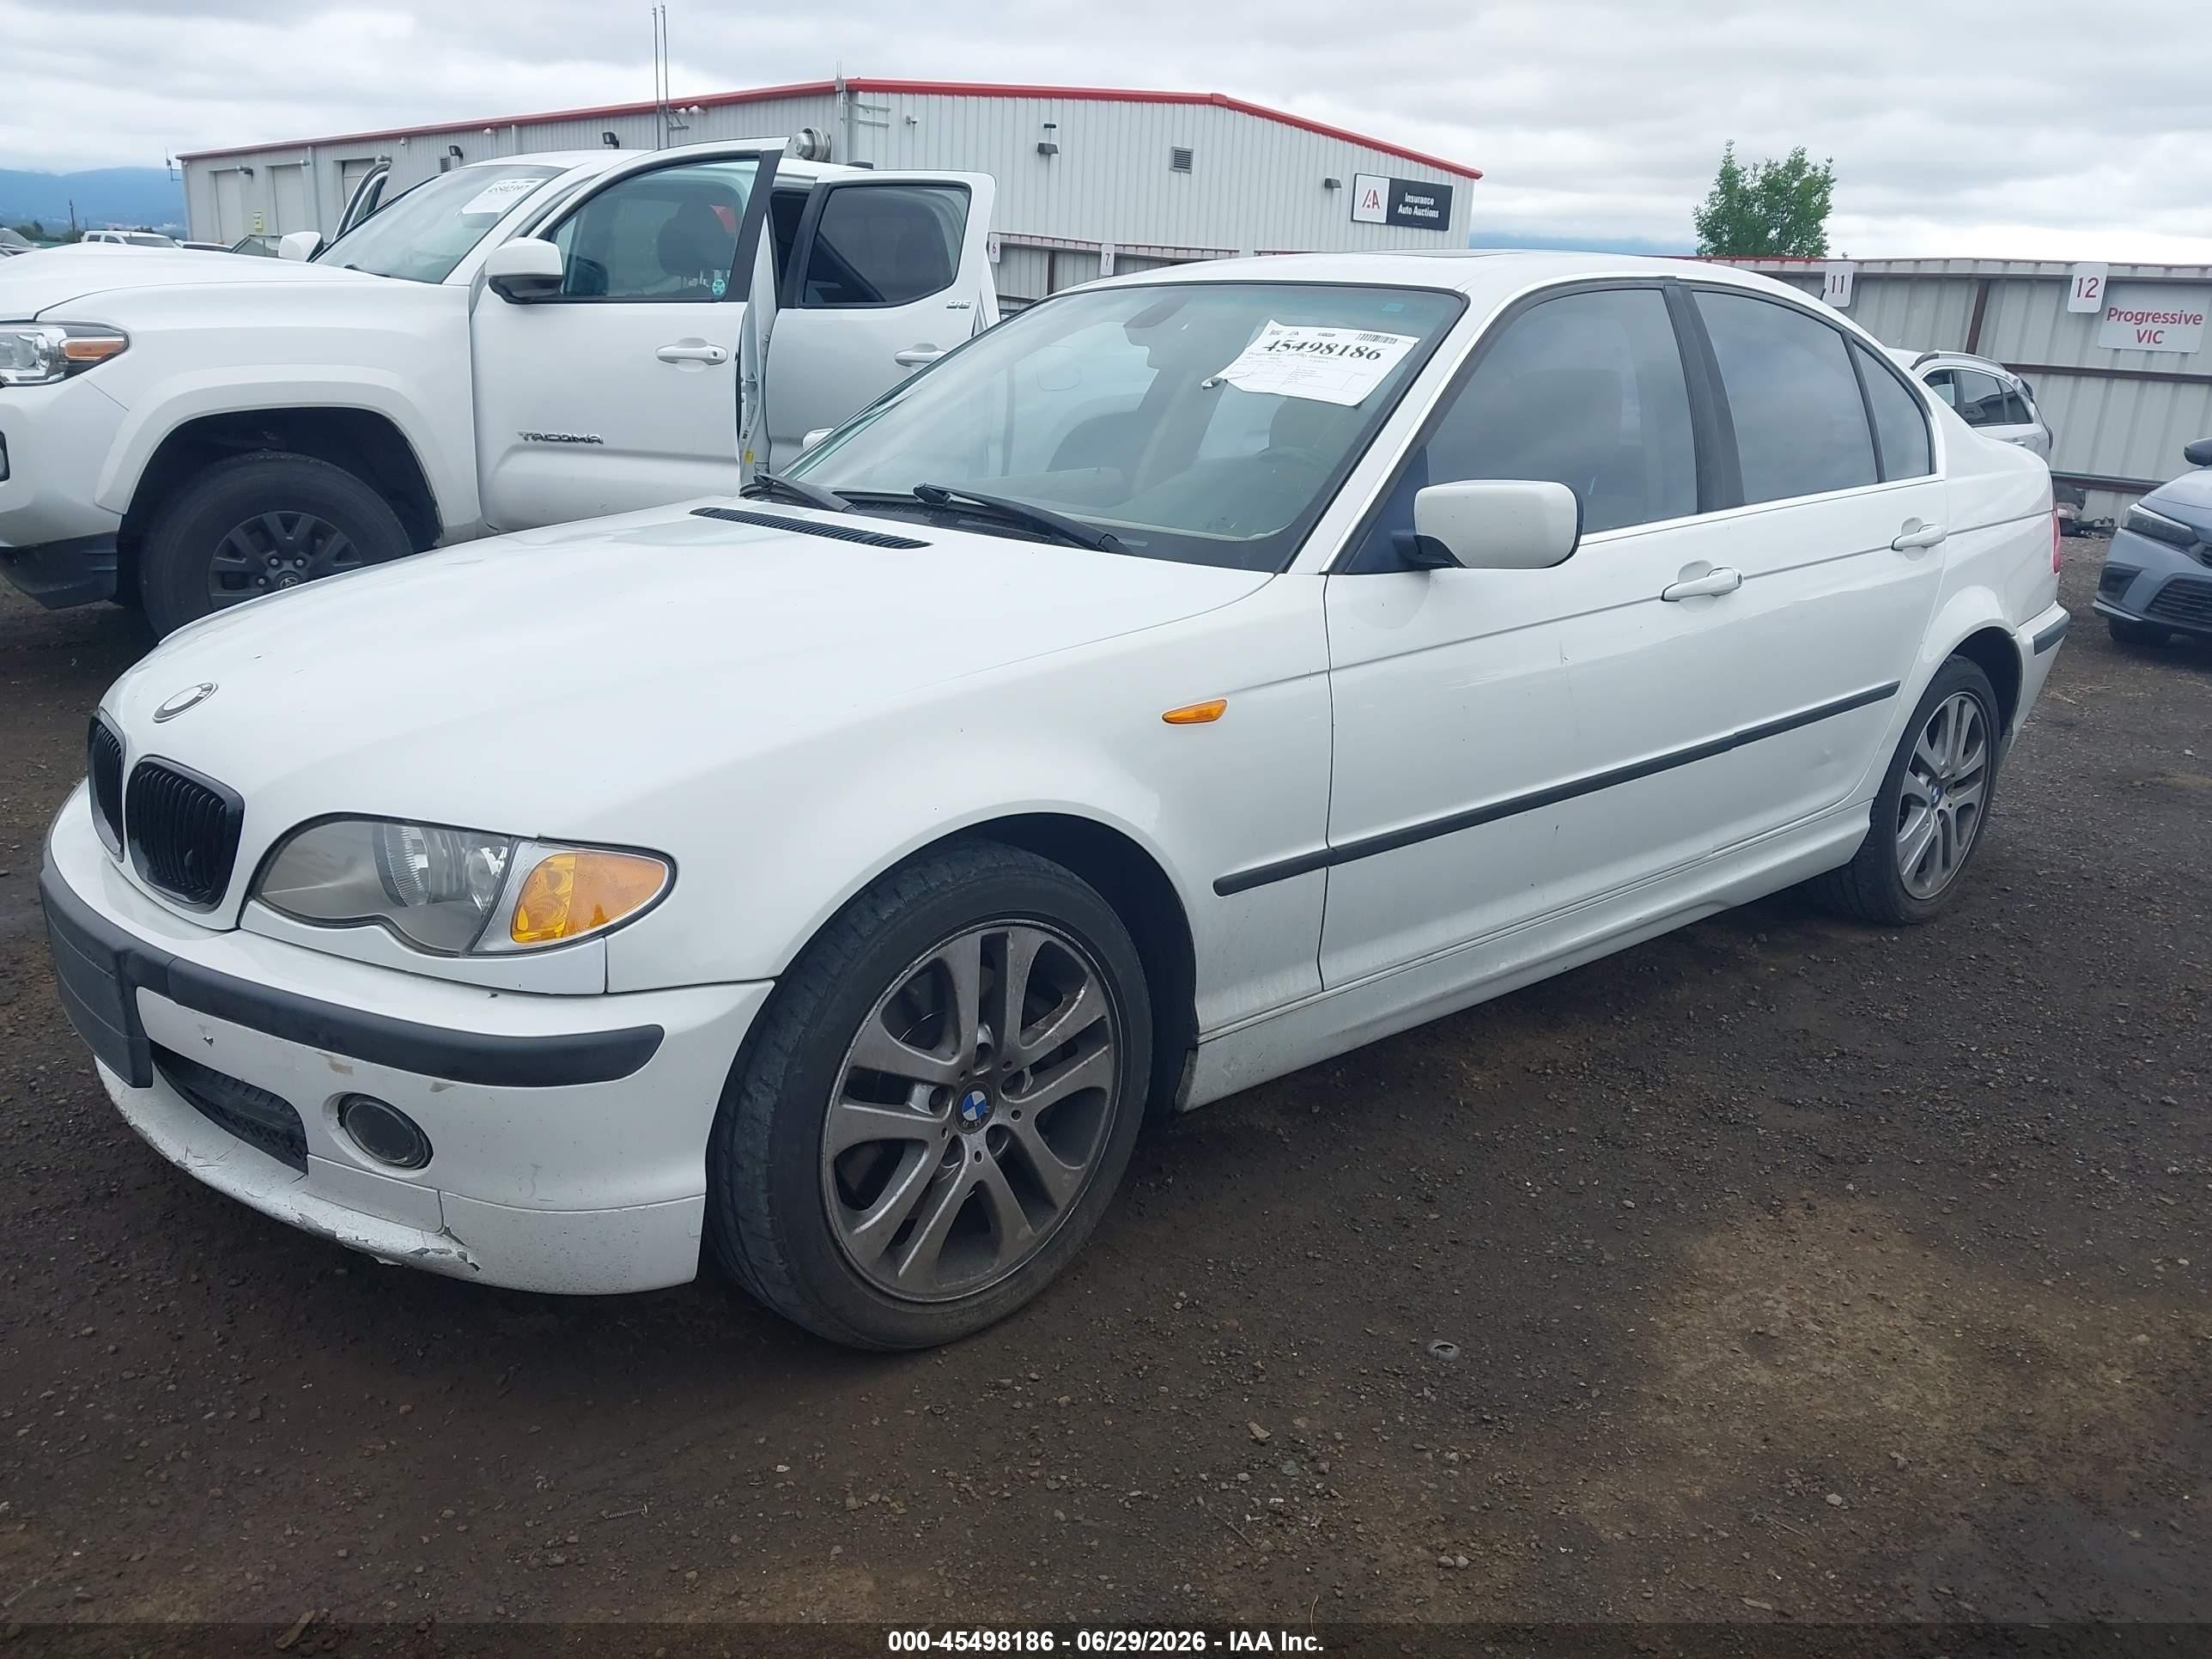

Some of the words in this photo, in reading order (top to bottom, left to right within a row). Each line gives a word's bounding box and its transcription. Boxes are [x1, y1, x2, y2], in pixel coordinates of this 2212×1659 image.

[1405, 192, 1435, 206] Insurance
[1397, 204, 1413, 215] Auto
[1413, 205, 1439, 218] Auctions
[992, 241, 997, 254] 6
[1105, 253, 1110, 266] 7
[1829, 275, 1846, 294] 11
[2075, 276, 2100, 298] 12
[2106, 307, 2203, 327] Progressive
[2136, 328, 2165, 345] VIC
[1263, 339, 1387, 361] 45498186
[518, 432, 604, 444] TACOMA
